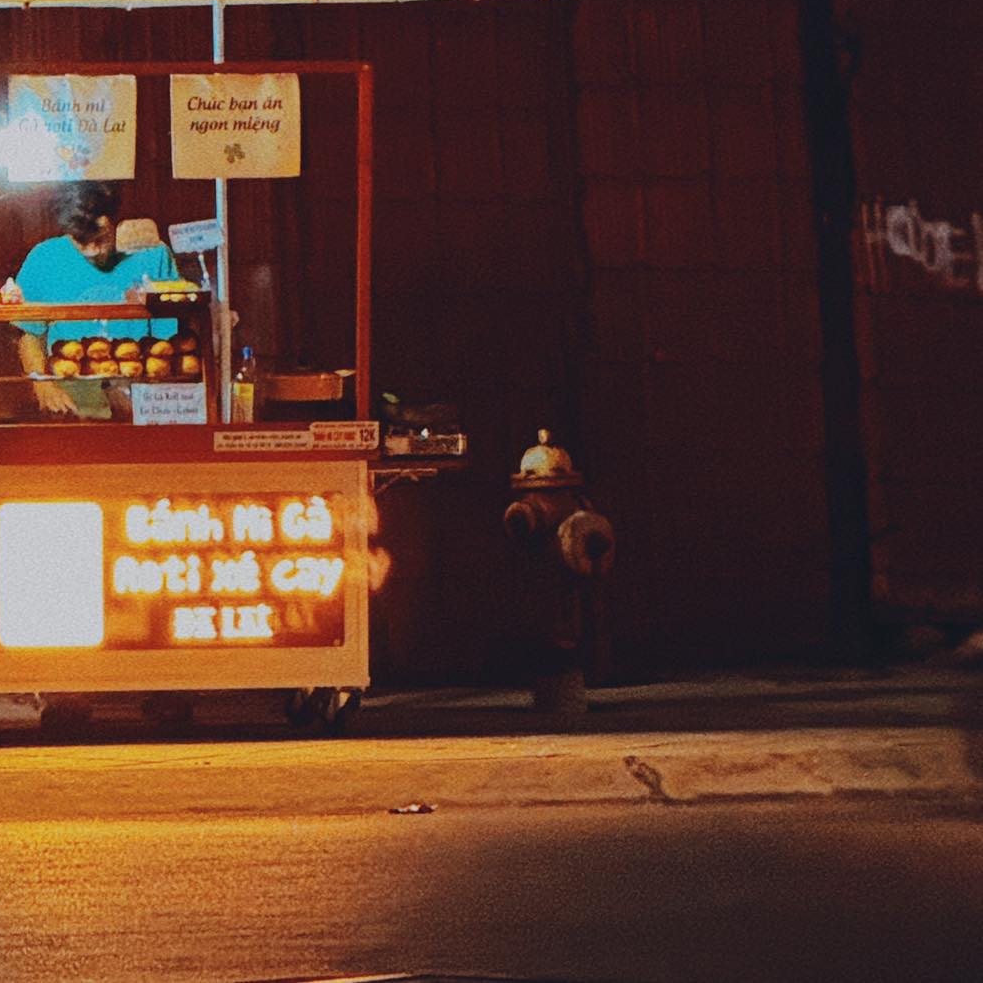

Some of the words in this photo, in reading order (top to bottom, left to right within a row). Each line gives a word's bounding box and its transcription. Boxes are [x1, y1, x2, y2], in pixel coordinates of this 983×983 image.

[187, 96, 225, 111] Chúc
[229, 97, 258, 113] bạn
[189, 120, 228, 135] ngon
[233, 116, 281, 134] miệng
[359, 429, 376, 443] 12K
